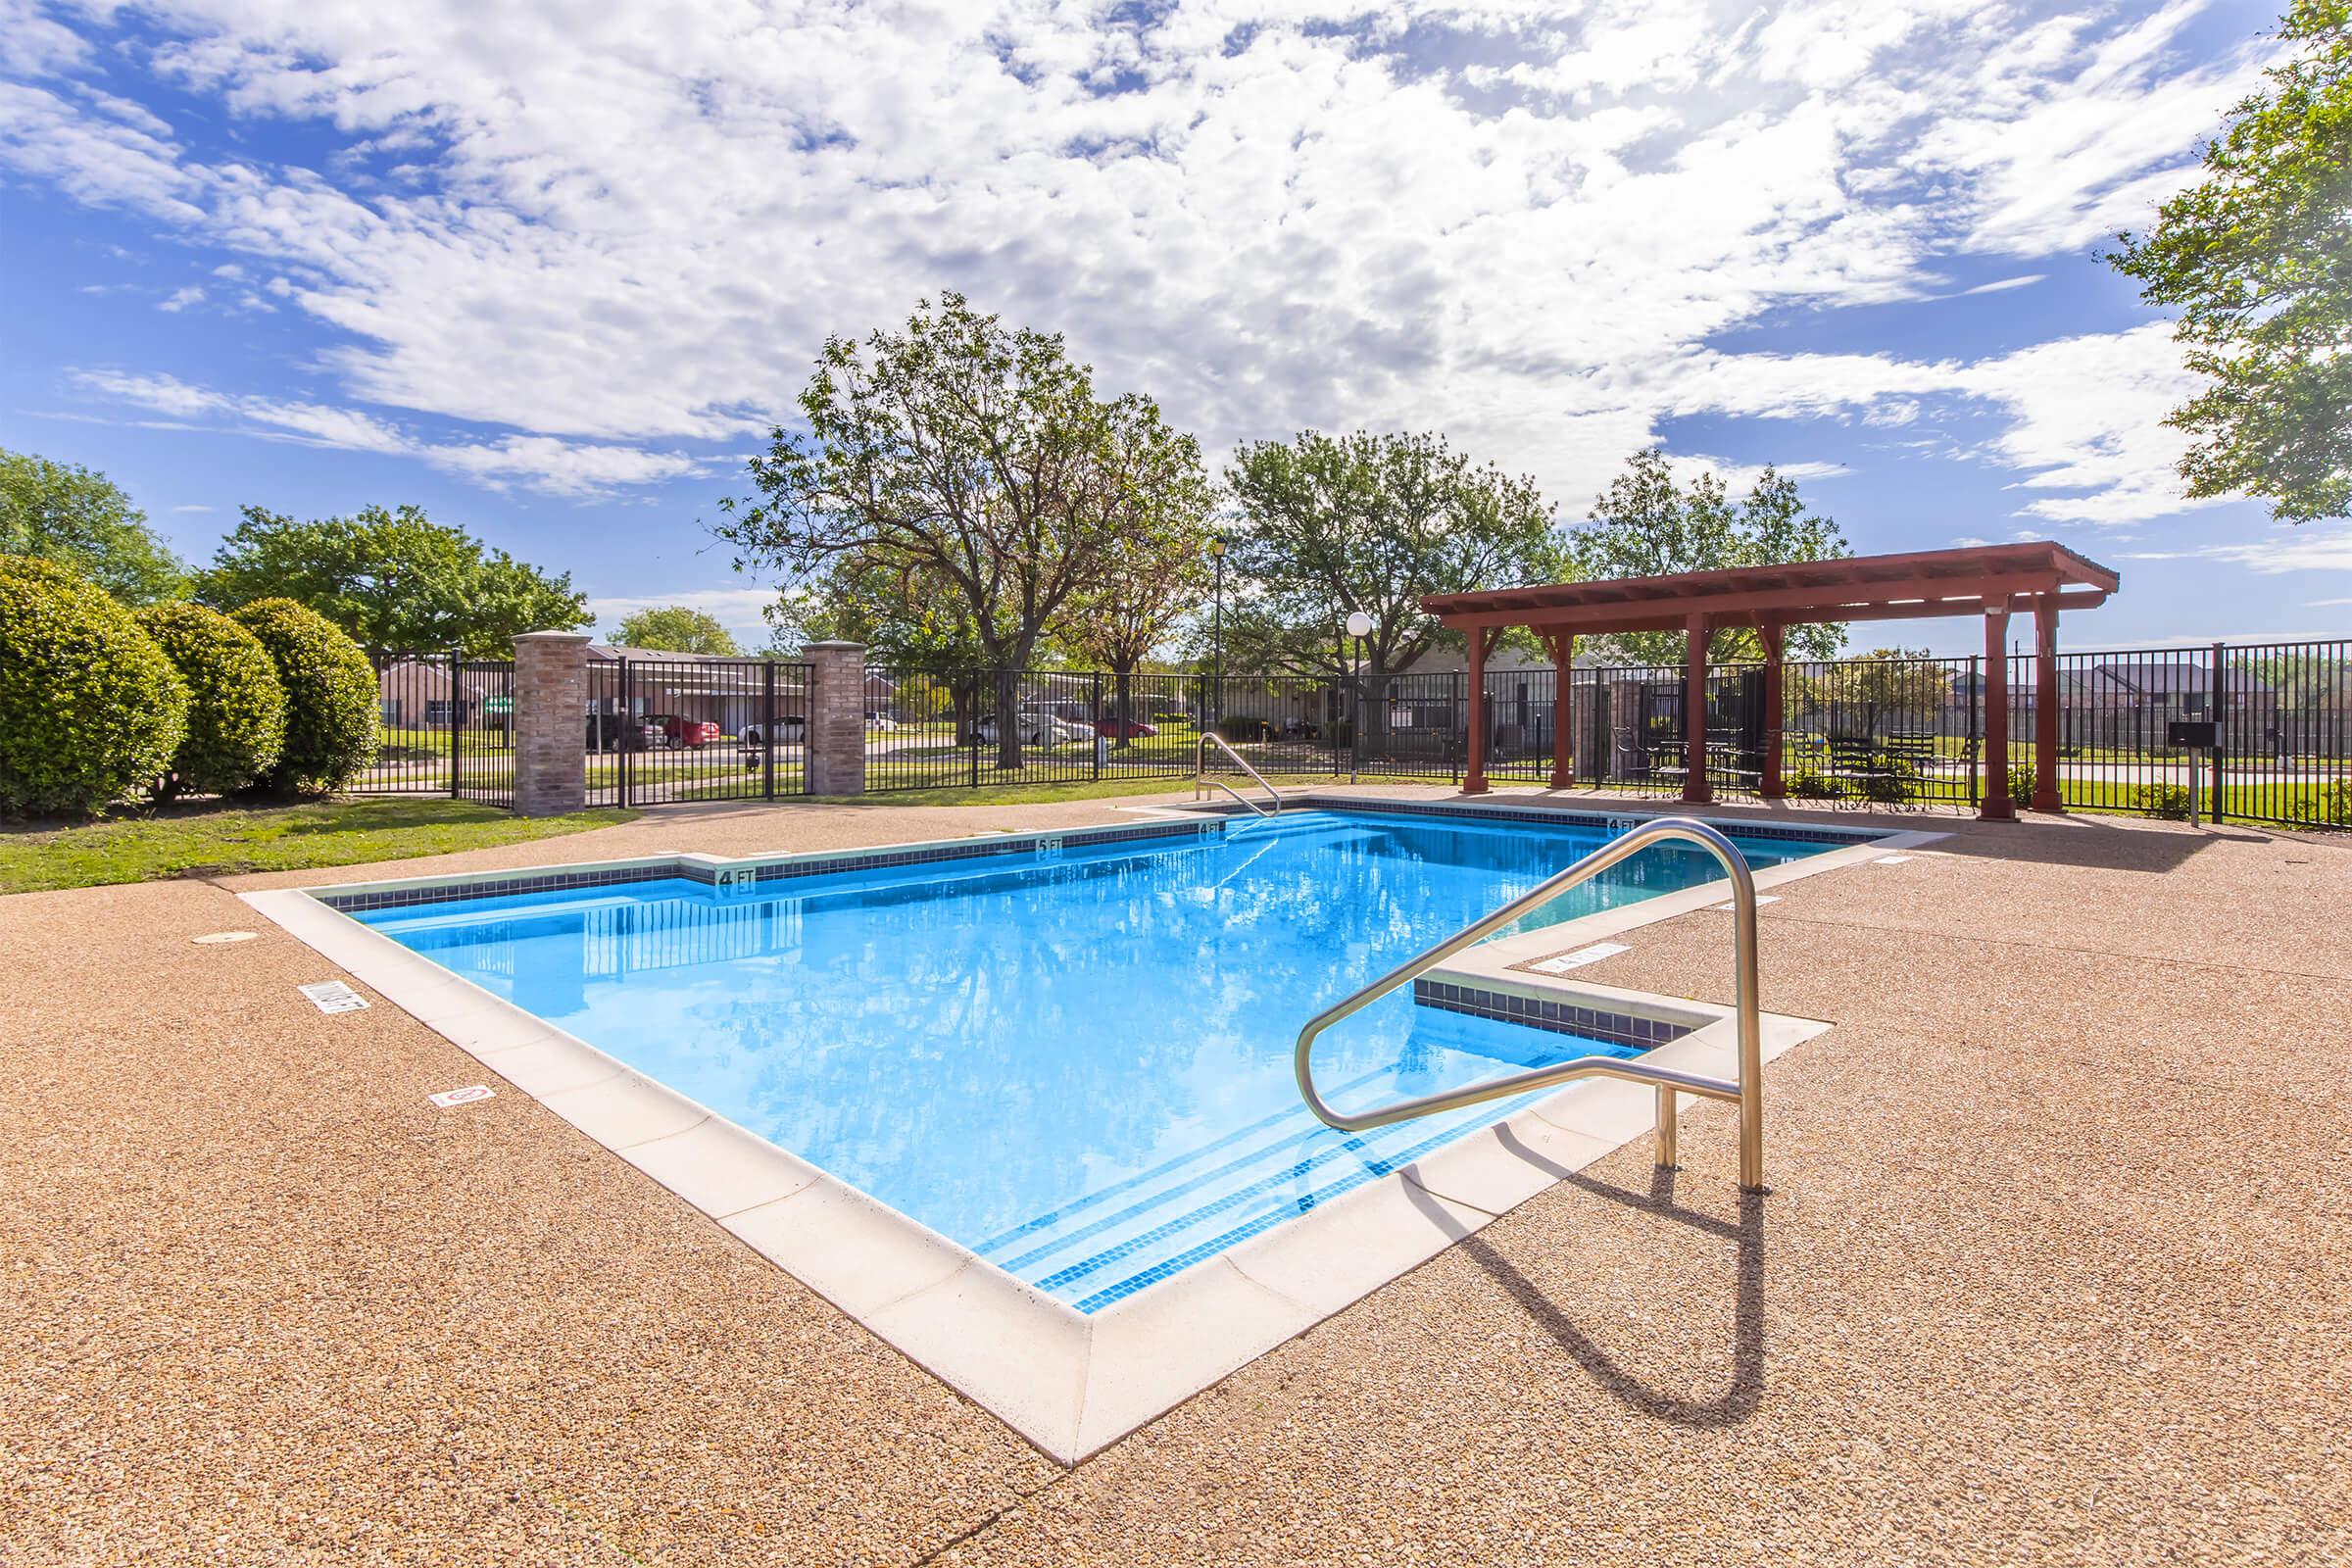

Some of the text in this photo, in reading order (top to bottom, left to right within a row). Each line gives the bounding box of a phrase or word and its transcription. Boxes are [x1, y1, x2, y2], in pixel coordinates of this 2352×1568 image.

[1200, 822, 1207, 833] 4
[1609, 818, 1634, 831] 4 FT
[1039, 838, 1061, 851] 5 FT
[718, 869, 754, 885] 4 FT
